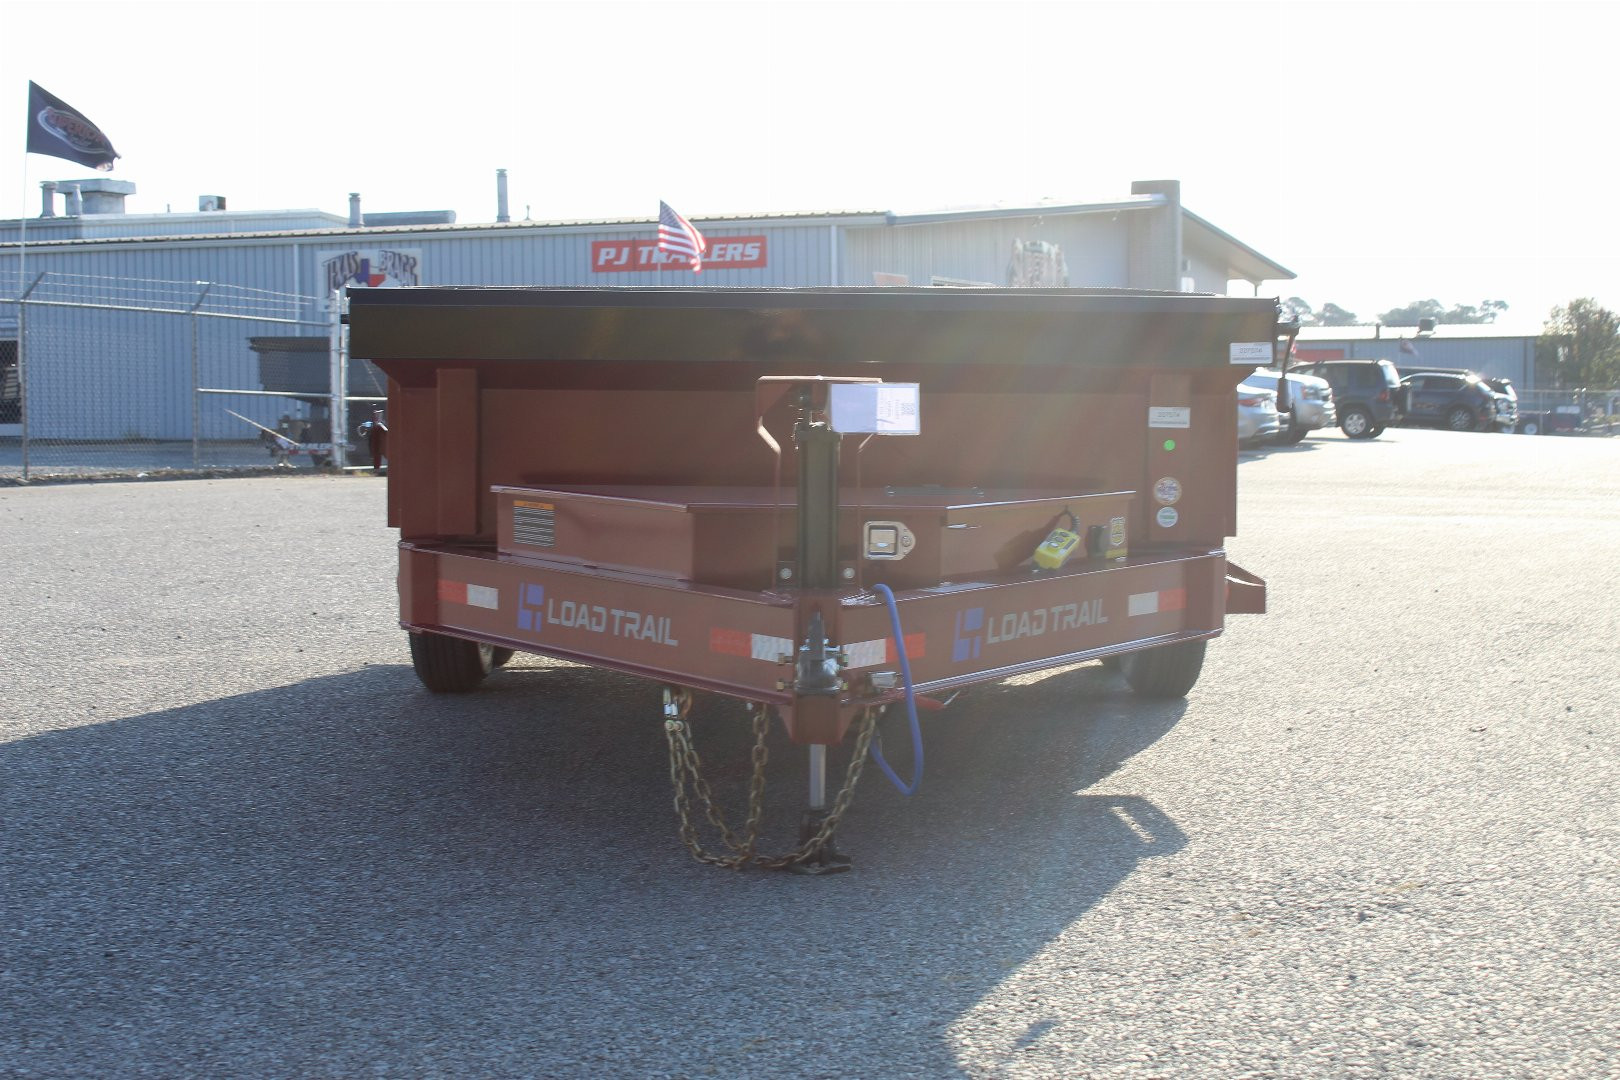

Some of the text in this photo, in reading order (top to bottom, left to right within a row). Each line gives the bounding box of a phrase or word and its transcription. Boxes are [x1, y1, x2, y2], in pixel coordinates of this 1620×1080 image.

[322, 250, 358, 297] TEXAS
[598, 247, 630, 265] PJ
[547, 598, 678, 647] LOAD TRAIL
[987, 599, 1109, 644] LOAD TRAIL
